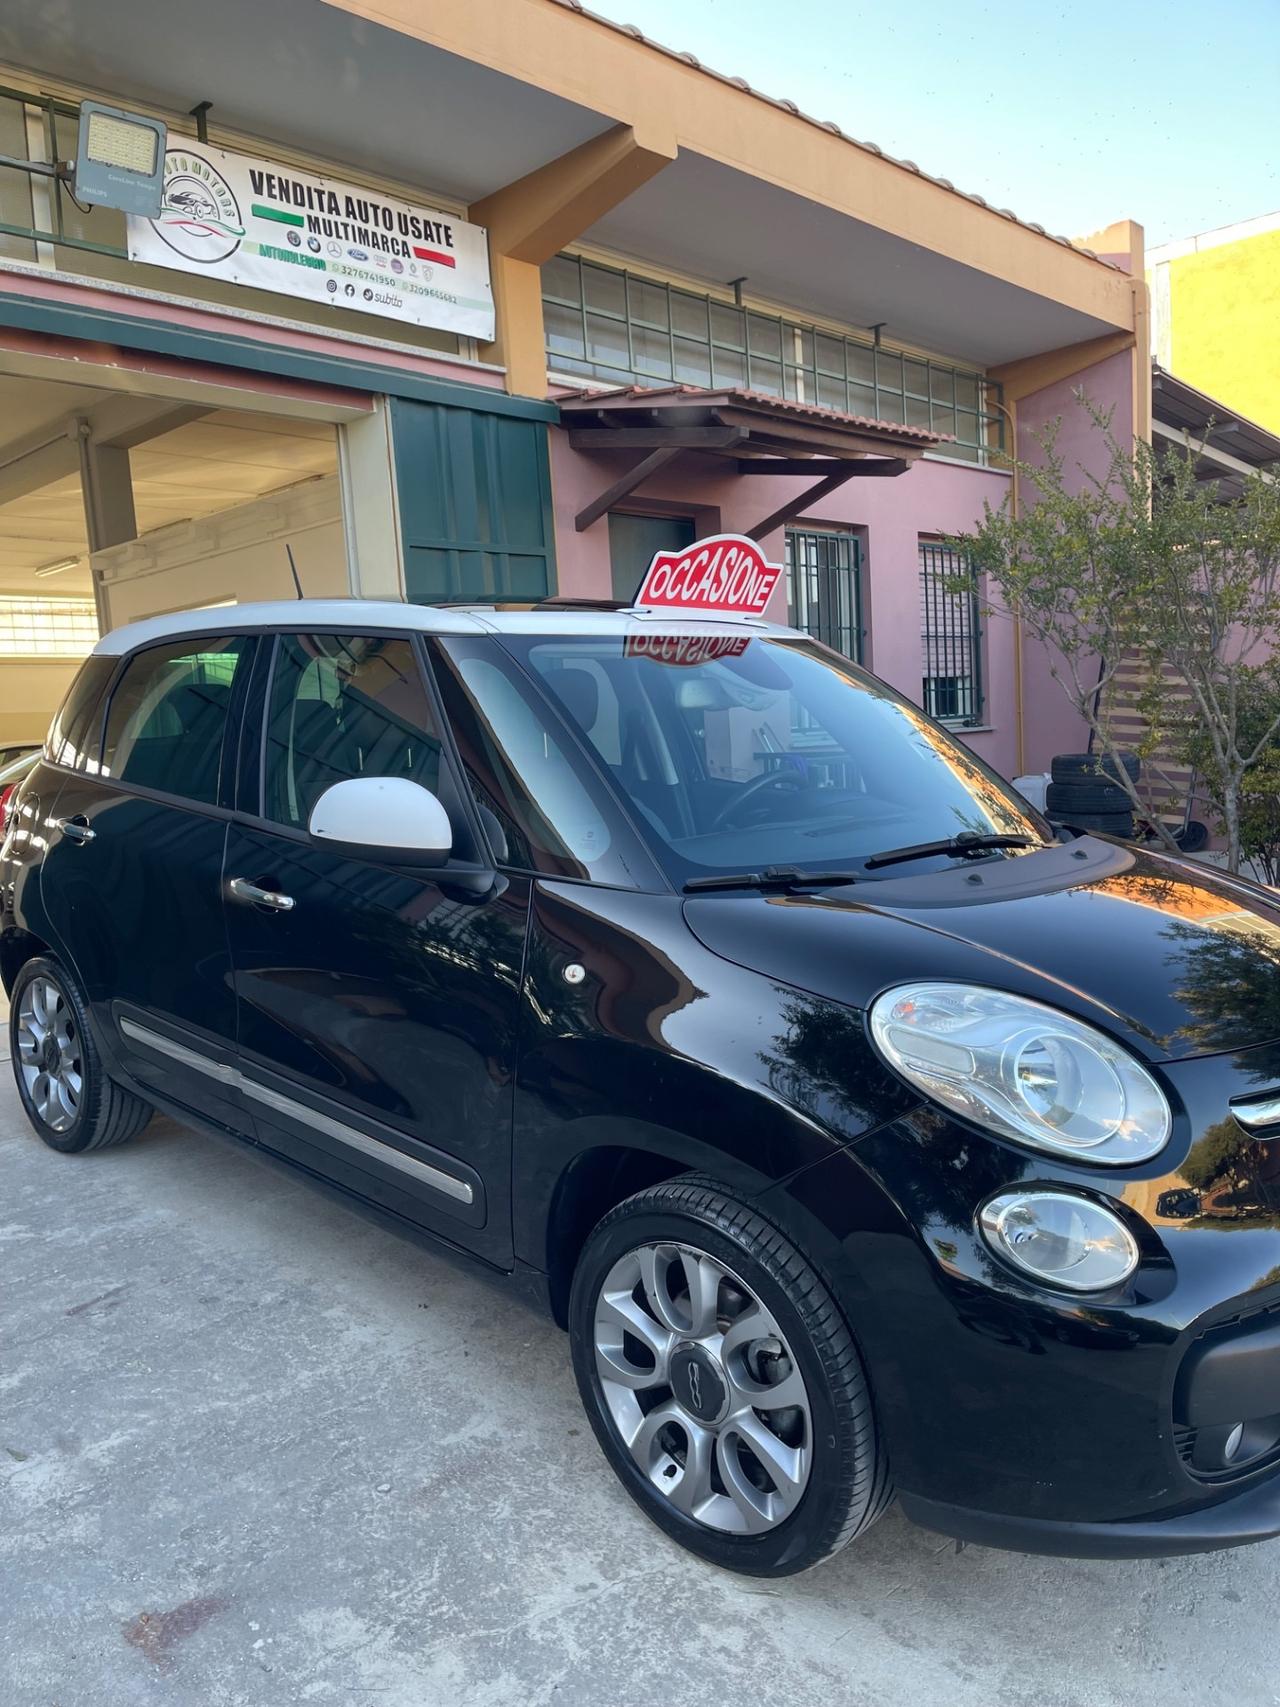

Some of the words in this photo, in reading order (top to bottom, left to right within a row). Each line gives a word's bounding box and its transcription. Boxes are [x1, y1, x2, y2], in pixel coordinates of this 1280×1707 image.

[191, 161, 236, 217] MOTORS
[248, 168, 342, 216] VENDITA
[344, 195, 394, 232] AUTO
[397, 211, 454, 248] USATE
[306, 213, 412, 259] MULTIMARCA
[341, 265, 396, 287] 3276741950
[374, 292, 403, 308] subito
[649, 546, 776, 607] OCCASIONE
